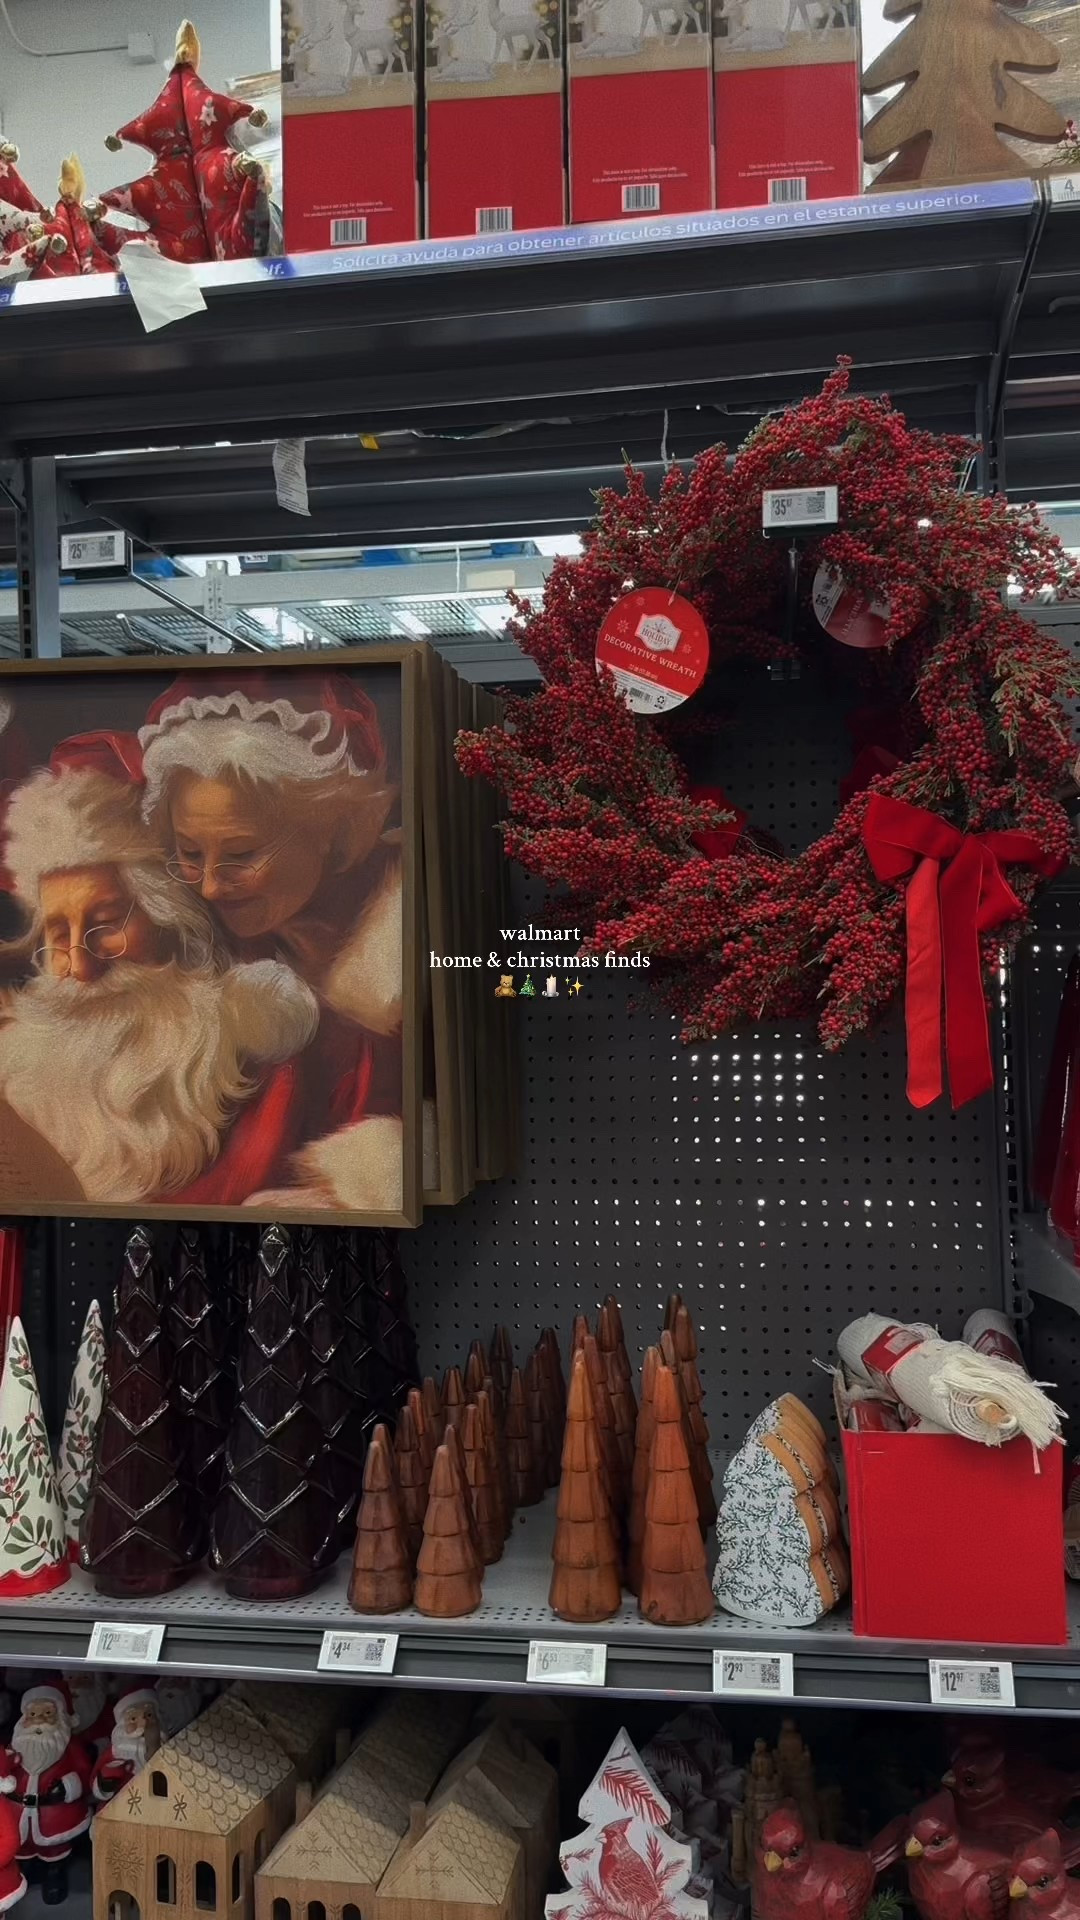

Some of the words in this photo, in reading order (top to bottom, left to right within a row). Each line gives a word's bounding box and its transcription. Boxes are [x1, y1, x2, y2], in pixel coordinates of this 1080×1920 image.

[332, 254, 397, 270] Solicita
[402, 246, 458, 264] ayuda
[462, 242, 503, 257] para
[508, 236, 584, 251] obtener
[676, 212, 759, 235] situados
[764, 212, 789, 225] en
[794, 204, 811, 221] el
[815, 203, 890, 219] estante
[896, 193, 985, 212] superior.
[603, 633, 657, 662] DECORATIVE
[659, 656, 697, 678] WREATH
[640, 626, 672, 646] HOLIDAY
